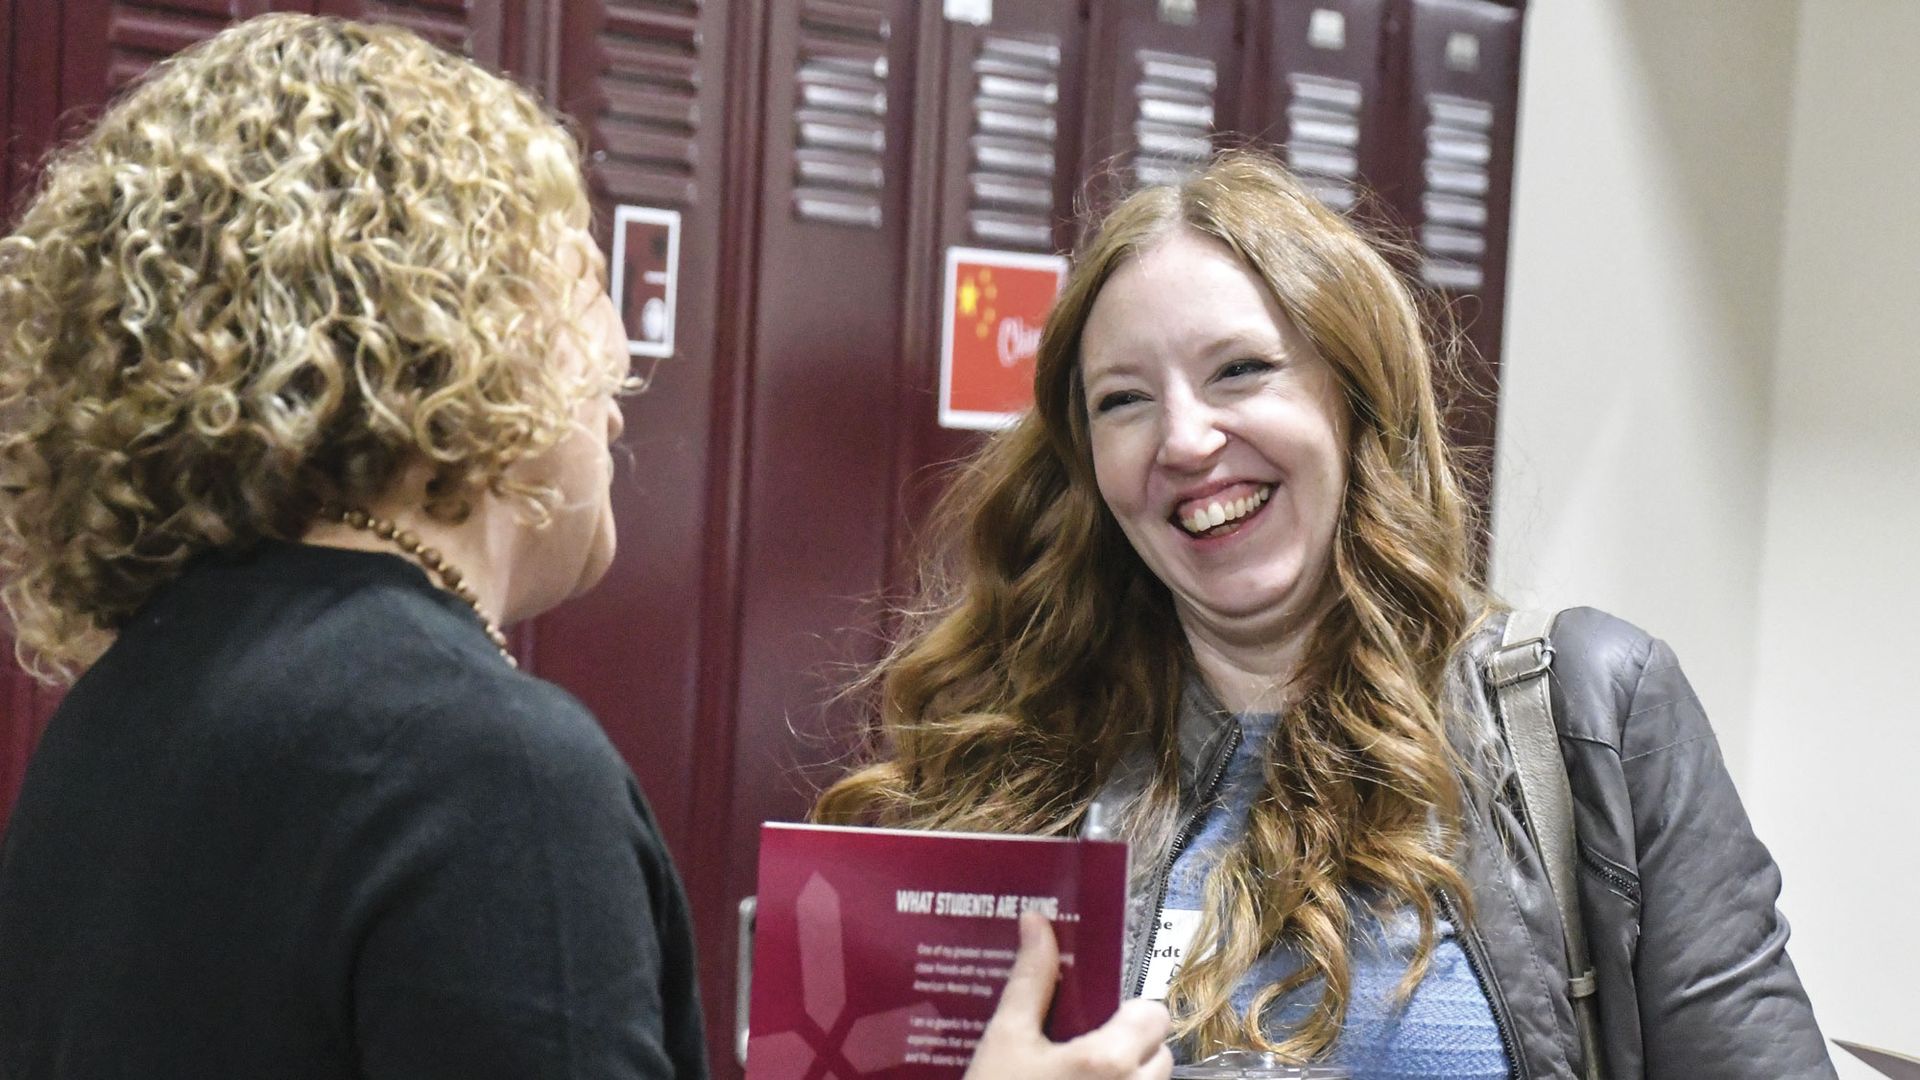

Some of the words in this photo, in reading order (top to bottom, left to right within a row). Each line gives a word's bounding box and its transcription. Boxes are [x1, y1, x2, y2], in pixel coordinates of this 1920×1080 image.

[896, 889, 934, 914] WHAT
[935, 892, 995, 918] STUDENTS
[996, 895, 1019, 919] ARE
